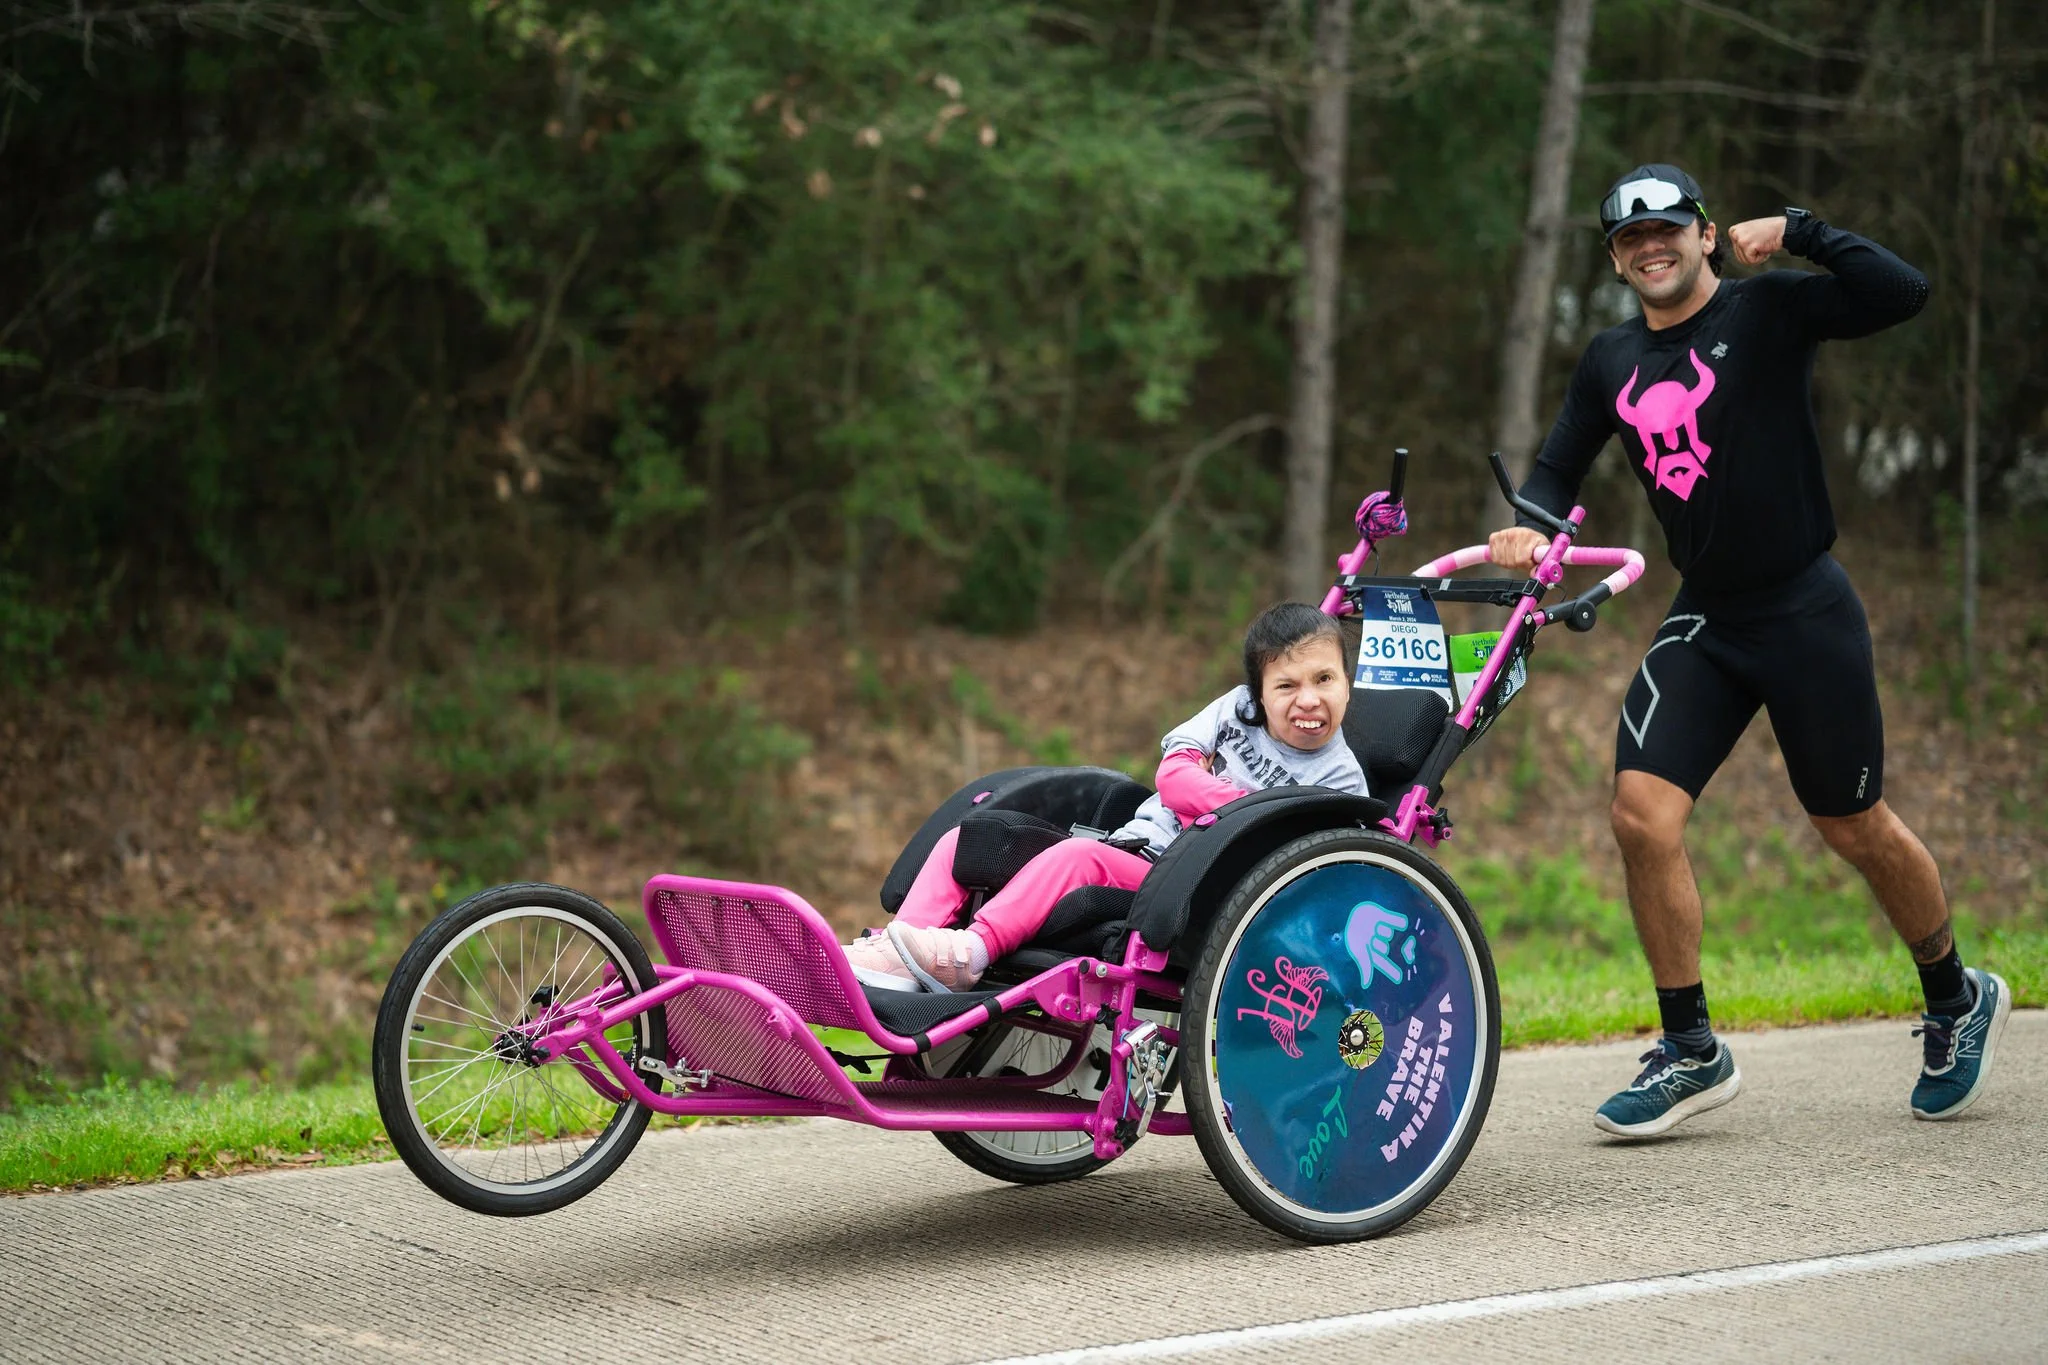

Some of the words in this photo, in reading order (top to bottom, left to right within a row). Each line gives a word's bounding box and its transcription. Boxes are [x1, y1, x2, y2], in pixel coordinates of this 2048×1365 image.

[1364, 636, 1441, 661] 3616C
[1391, 624, 1419, 635] DIEGO
[1856, 767, 1868, 799] 2XU
[1375, 1015, 1424, 1122] BRAVE
[1380, 992, 1453, 1163] VALENTINA
[1404, 1046, 1433, 1106] THE
[1299, 1084, 1348, 1179] Love
